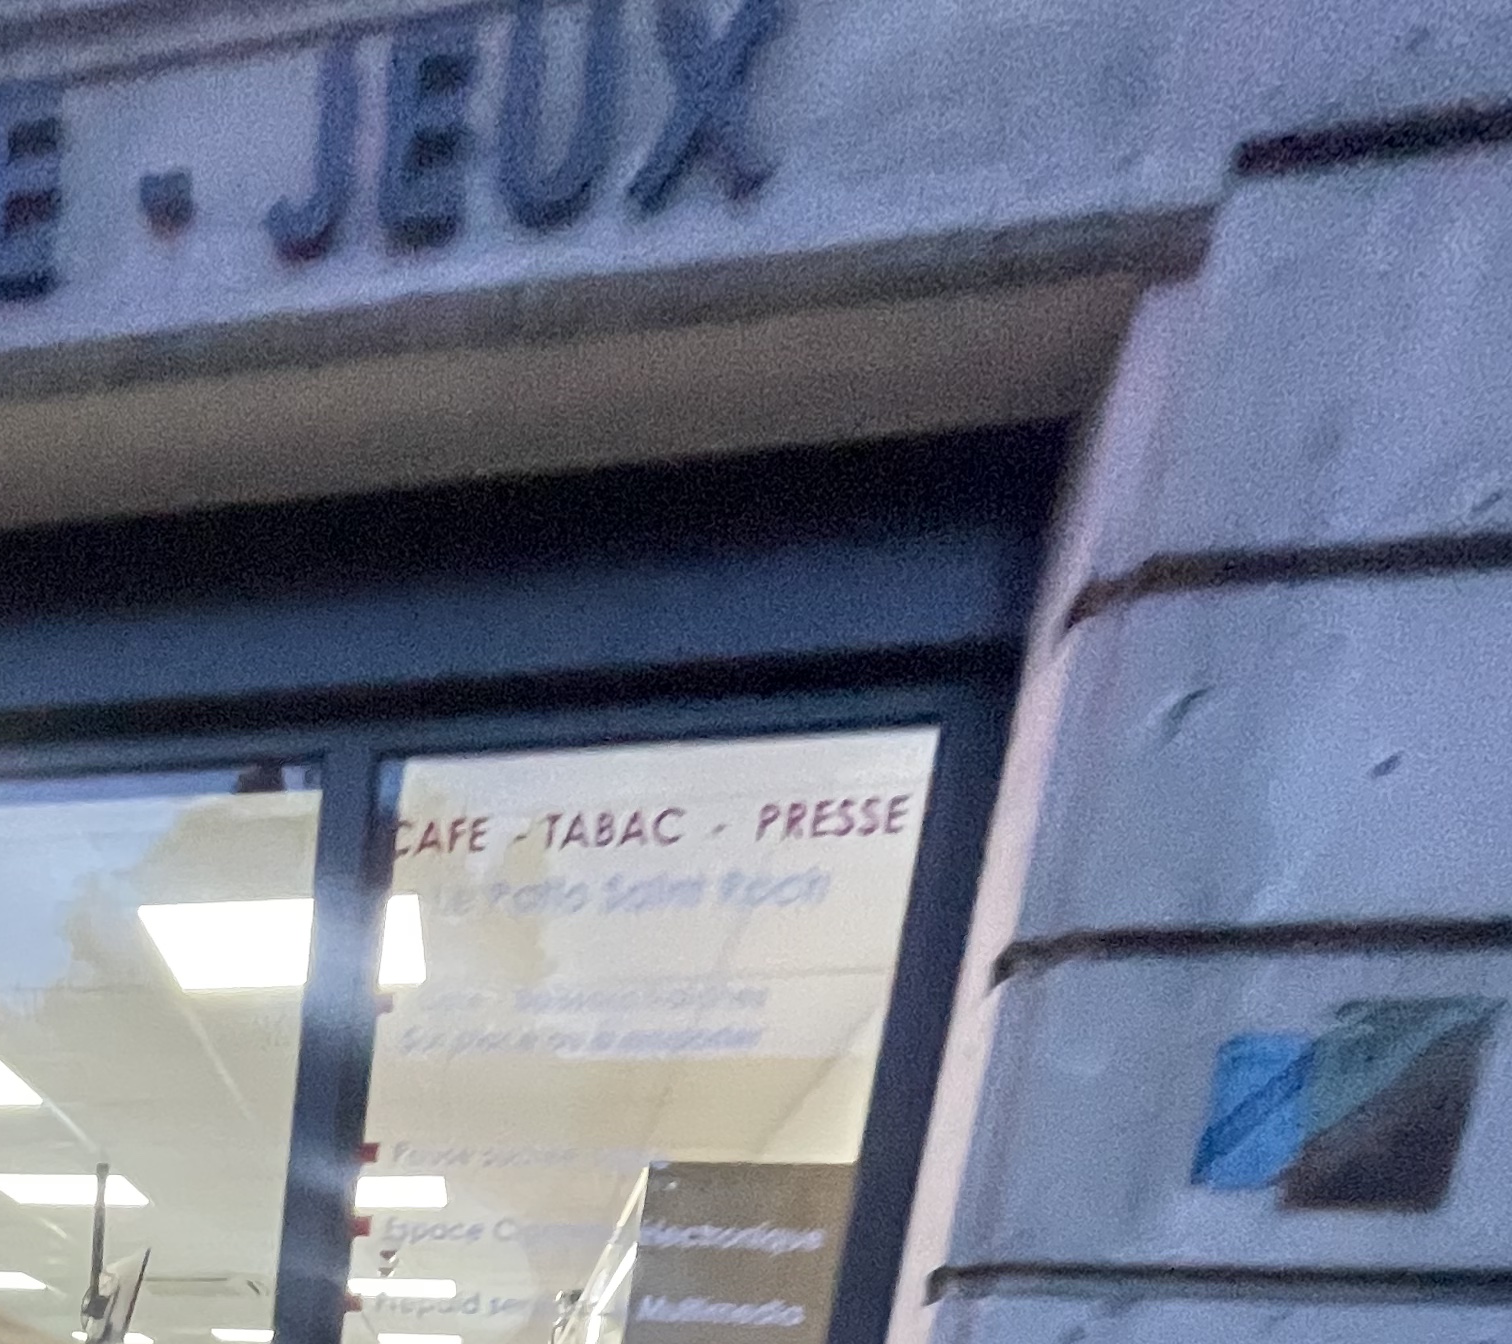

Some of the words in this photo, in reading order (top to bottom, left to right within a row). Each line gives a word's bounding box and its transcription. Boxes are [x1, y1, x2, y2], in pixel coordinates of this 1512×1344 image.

[266, 0, 784, 262] JEUX
[393, 813, 491, 858] CAFE
[541, 806, 686, 851] TABAC
[754, 793, 911, 842] PRESSE
